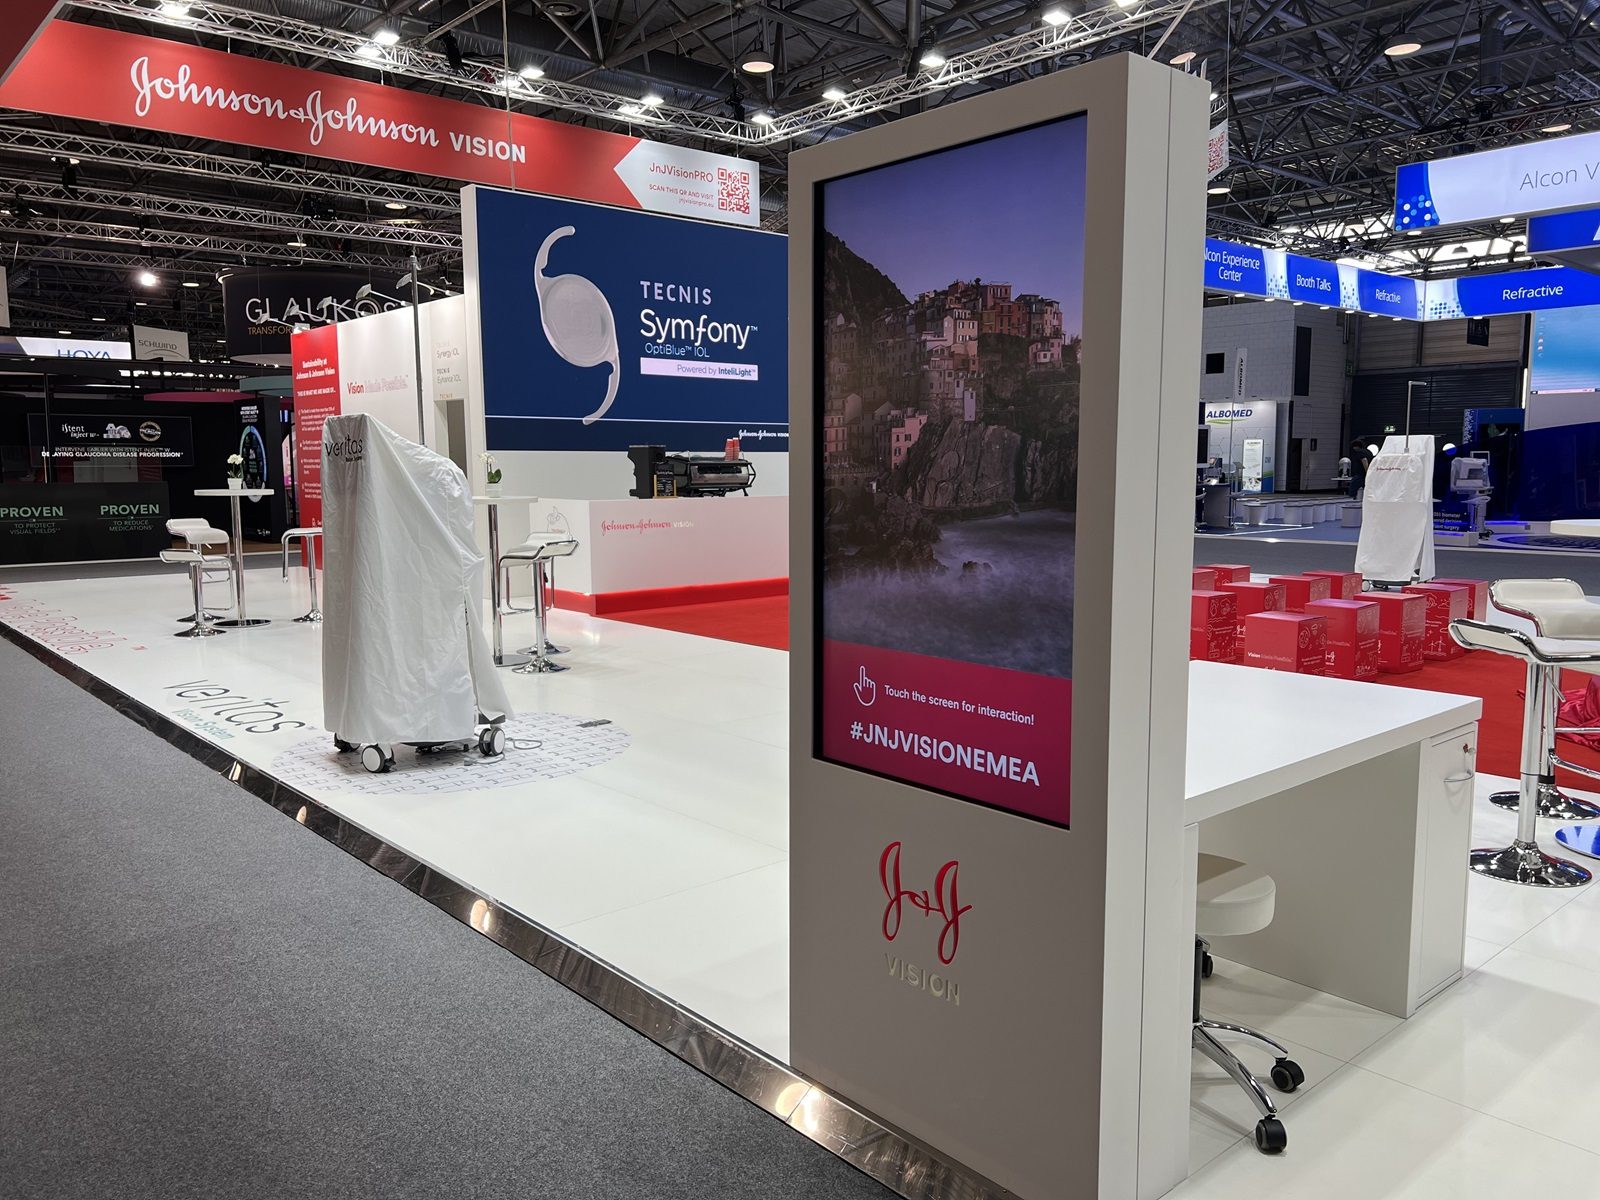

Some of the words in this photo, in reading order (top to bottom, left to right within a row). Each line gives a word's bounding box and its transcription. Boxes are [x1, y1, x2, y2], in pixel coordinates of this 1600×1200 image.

[450, 131, 526, 163] VISION
[650, 162, 713, 183] JnJVisionPRO
[1519, 170, 1577, 191] Alcon
[650, 184, 665, 192] SCAN
[666, 186, 678, 194] THIS
[680, 188, 688, 197] QR
[688, 190, 700, 198] AND
[1222, 250, 1259, 270] Experience
[1218, 267, 1242, 282] Center
[1296, 274, 1315, 289] Booth
[1316, 277, 1331, 292] Talks
[640, 281, 712, 305] TECNIS
[1375, 288, 1401, 304] Refractive
[1502, 284, 1564, 301] Refractive
[248, 326, 296, 336] TRANSFOR
[694, 346, 710, 357] IOL
[677, 364, 706, 374] Powered
[708, 366, 717, 375] by
[347, 382, 364, 395] Vision
[1206, 409, 1253, 419] ALBOMED
[325, 434, 363, 456] veritas
[0, 506, 64, 517] PROVEN
[100, 504, 160, 515] PROVEN
[884, 685, 909, 700] Touch
[912, 691, 926, 703] the
[929, 695, 959, 710] screen
[962, 701, 975, 713] for
[978, 704, 1034, 725] interaction!
[851, 721, 1040, 786] #JNJVISIONEMEA
[885, 953, 960, 1006] VISION
